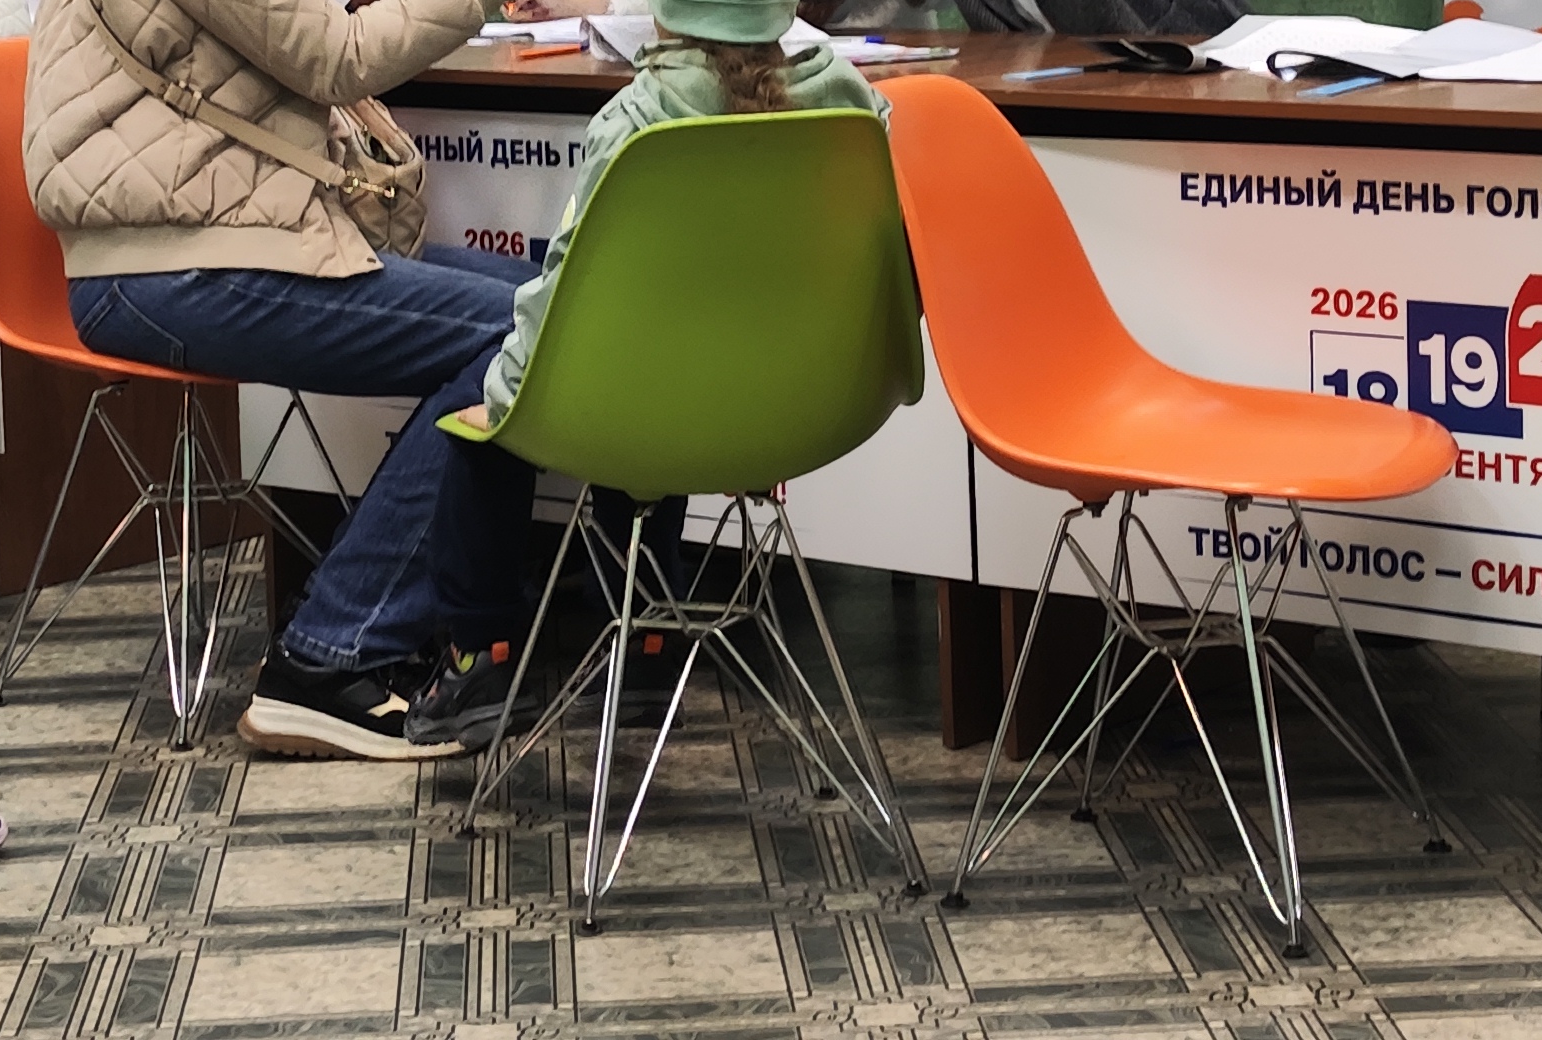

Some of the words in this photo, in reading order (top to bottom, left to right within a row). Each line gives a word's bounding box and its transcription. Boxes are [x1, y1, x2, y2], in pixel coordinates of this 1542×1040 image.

[490, 138, 561, 169] ДЕНЬ
[1180, 169, 1342, 209] ЕДИНЫЙ
[1353, 180, 1454, 215] ДЕНЬ
[464, 228, 525, 256] 2026
[1310, 287, 1399, 320] 2026
[1418, 333, 1499, 408] 19
[1188, 525, 1288, 566] ТВОЙ
[1300, 536, 1425, 582] ГОЛОС
